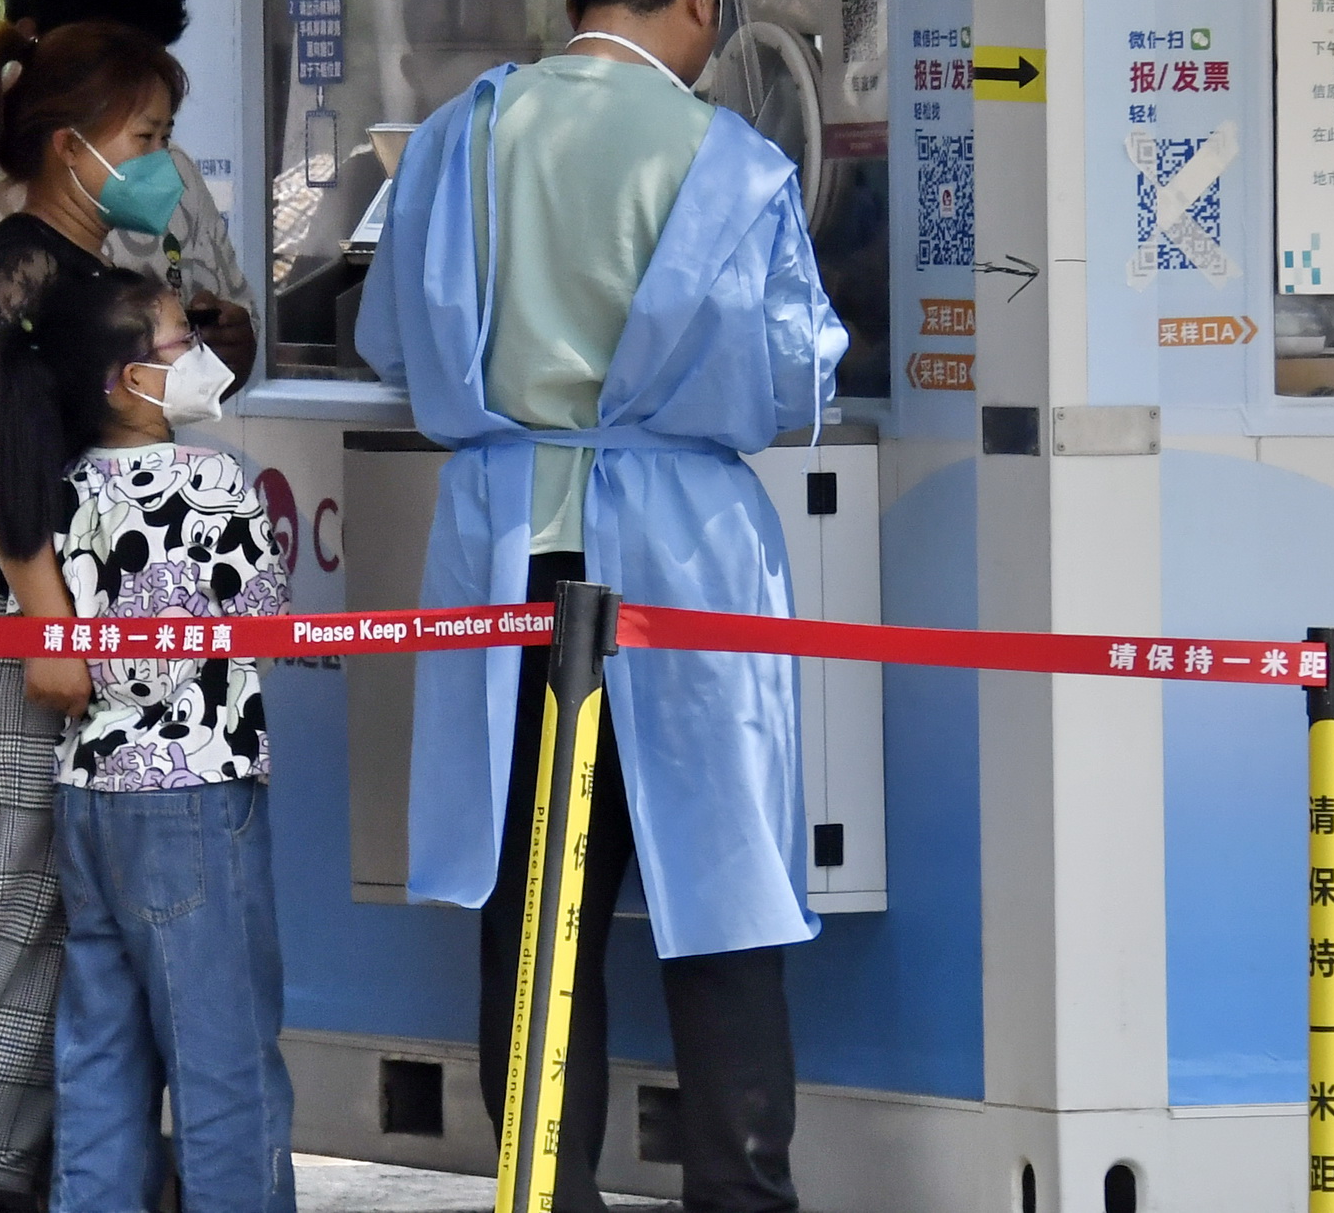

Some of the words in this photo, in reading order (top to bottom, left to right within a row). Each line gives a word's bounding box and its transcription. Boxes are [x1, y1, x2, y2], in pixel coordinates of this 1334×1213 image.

[913, 30, 957, 47] 微信扫一扫
[926, 307, 974, 330] 采样口A
[1160, 321, 1235, 344] 采样口A
[919, 361, 967, 384] 采样口B
[44, 623, 232, 653] 请保持一米距离
[294, 621, 354, 644] Please
[360, 619, 406, 643] Keep
[413, 615, 491, 637] 1-meter
[1108, 643, 1327, 679] 请保持一米距
[529, 805, 545, 878] Please
[523, 879, 537, 928] keep
[514, 945, 534, 1035] distance
[510, 1040, 524, 1063] of
[508, 1068, 519, 1105] one
[502, 1112, 515, 1171] meter
